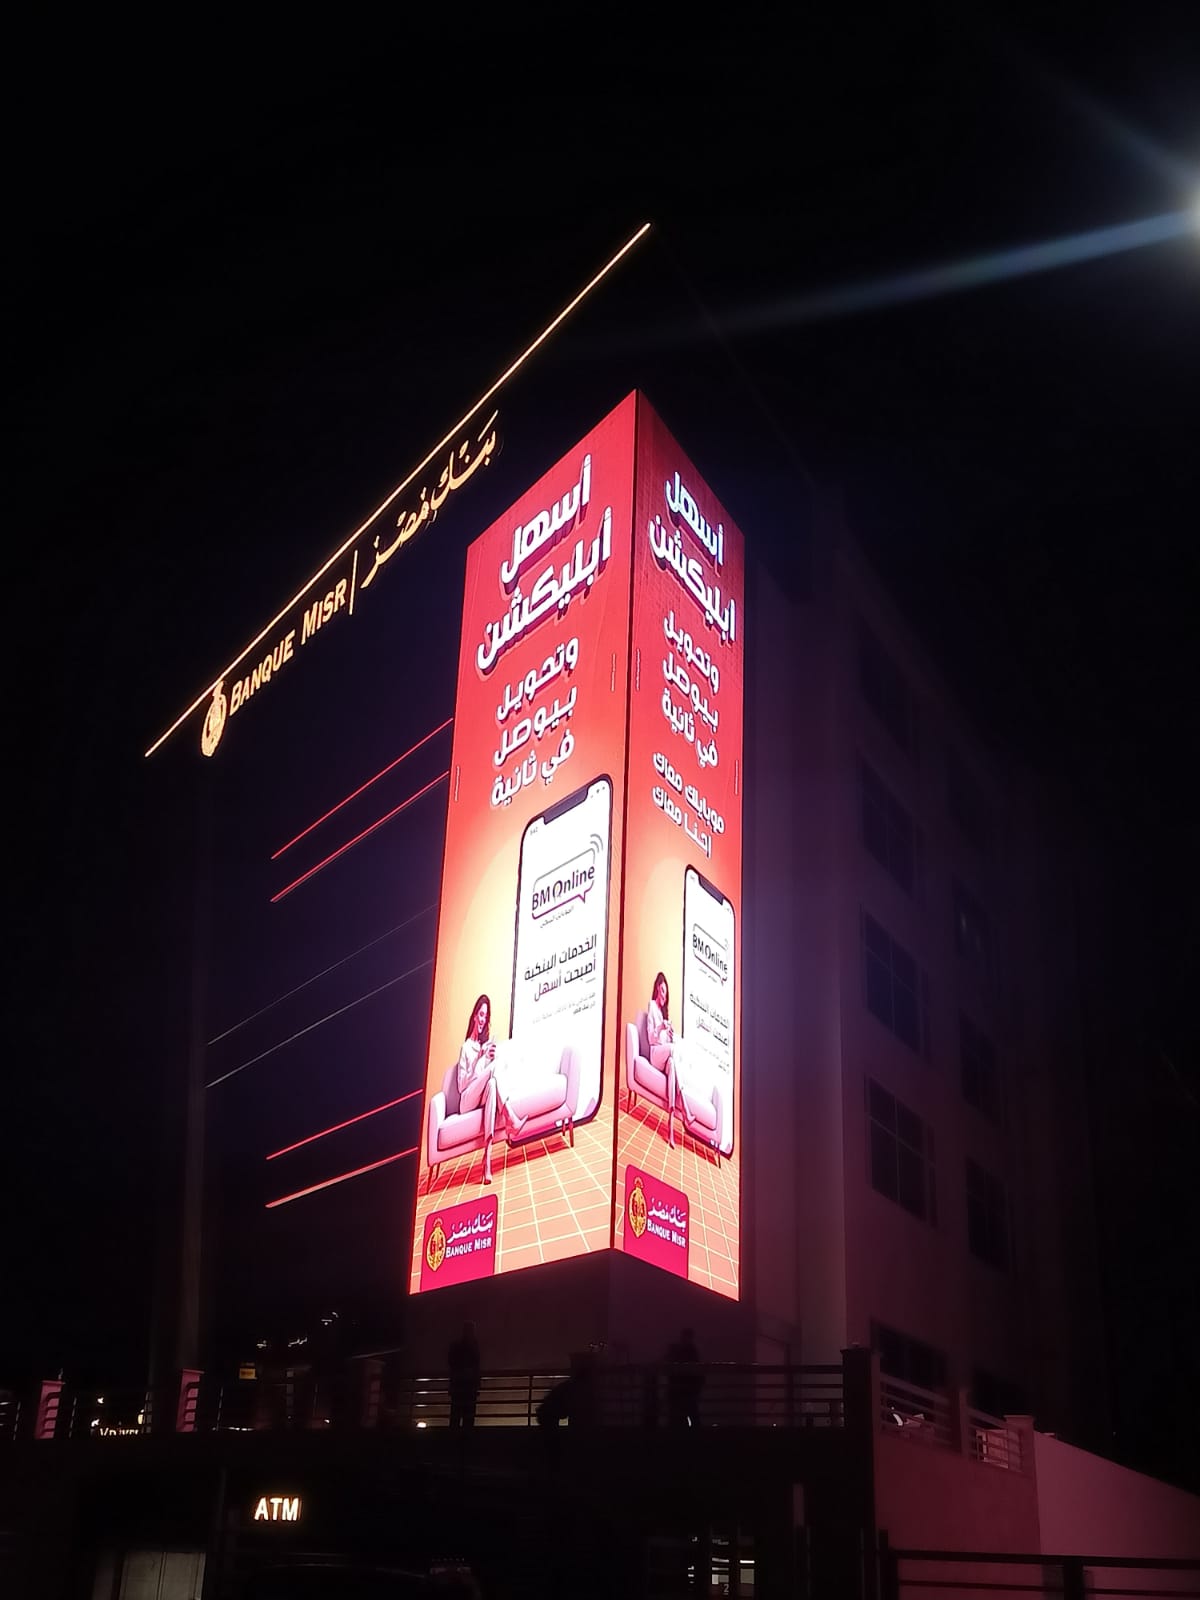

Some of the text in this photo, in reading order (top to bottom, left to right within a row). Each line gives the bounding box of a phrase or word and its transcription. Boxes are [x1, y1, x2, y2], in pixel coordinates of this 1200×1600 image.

[501, 453, 592, 584] أسهل
[664, 471, 724, 567] أسهل
[477, 505, 612, 671] أبليكشن
[229, 578, 347, 717] BANQUE MISR
[495, 636, 579, 721] وتحويل
[663, 609, 720, 694] وتحويل
[494, 685, 577, 767] بيوصل
[661, 687, 719, 768] في ثانية
[662, 651, 719, 733] بيوصل
[490, 728, 575, 806] في ثانية
[651, 786, 682, 827] معاك
[652, 752, 725, 834] موبايلك معاك
[531, 865, 596, 911] BM Online
[523, 933, 597, 982] الخدمات البنكية
[534, 952, 597, 1002] أصبحت أسهل
[692, 933, 704, 955] BM
[445, 1237, 492, 1258] BANQUE MISR
[647, 1218, 686, 1248] BANQUE MISR
[254, 1497, 299, 1521] ATM
